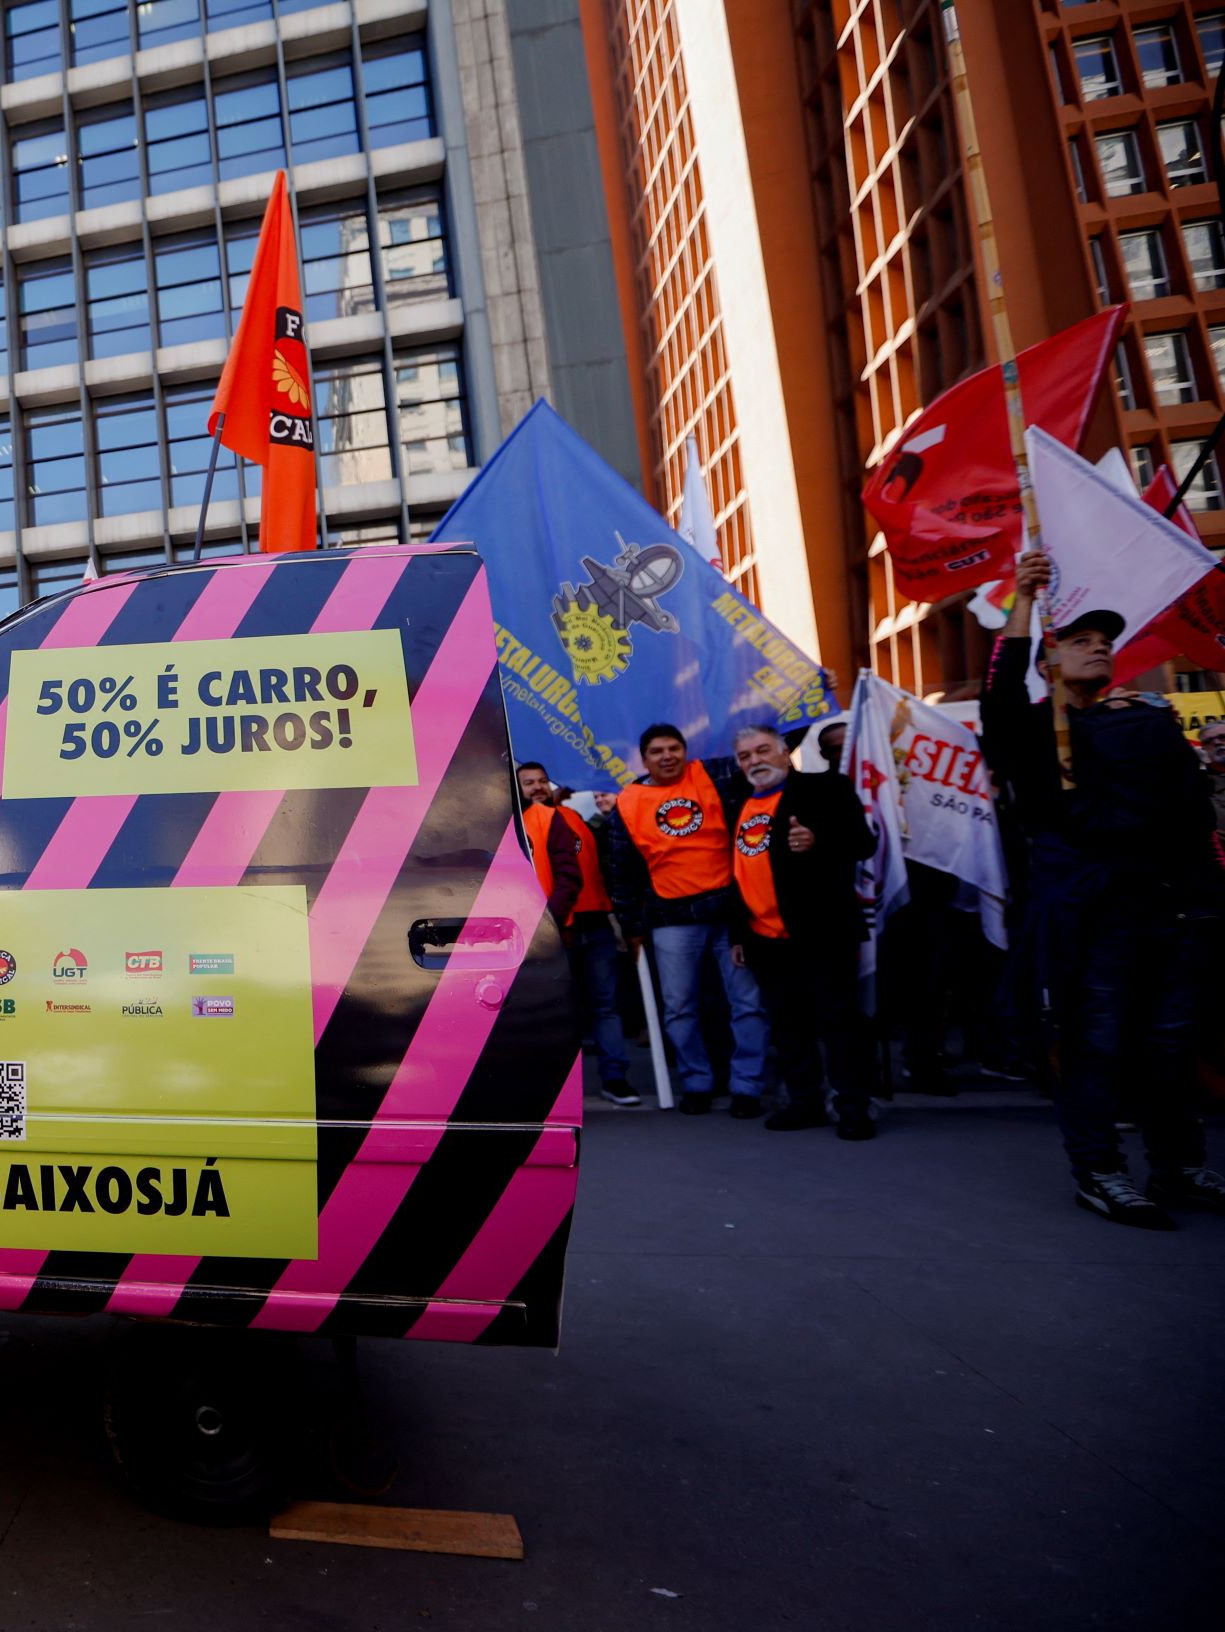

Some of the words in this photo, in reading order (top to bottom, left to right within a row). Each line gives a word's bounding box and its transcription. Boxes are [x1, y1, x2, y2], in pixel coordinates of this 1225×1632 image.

[948, 550, 987, 571] CUT
[36, 674, 138, 716] 50%
[157, 664, 179, 710] É
[197, 664, 378, 709] CARRO,
[58, 718, 164, 760] 50%
[181, 708, 353, 756] JUROS!
[930, 793, 970, 816] SÃO
[127, 955, 161, 969] CTB
[53, 967, 88, 979] UGT
[122, 1003, 163, 1015] PÚBLICA
